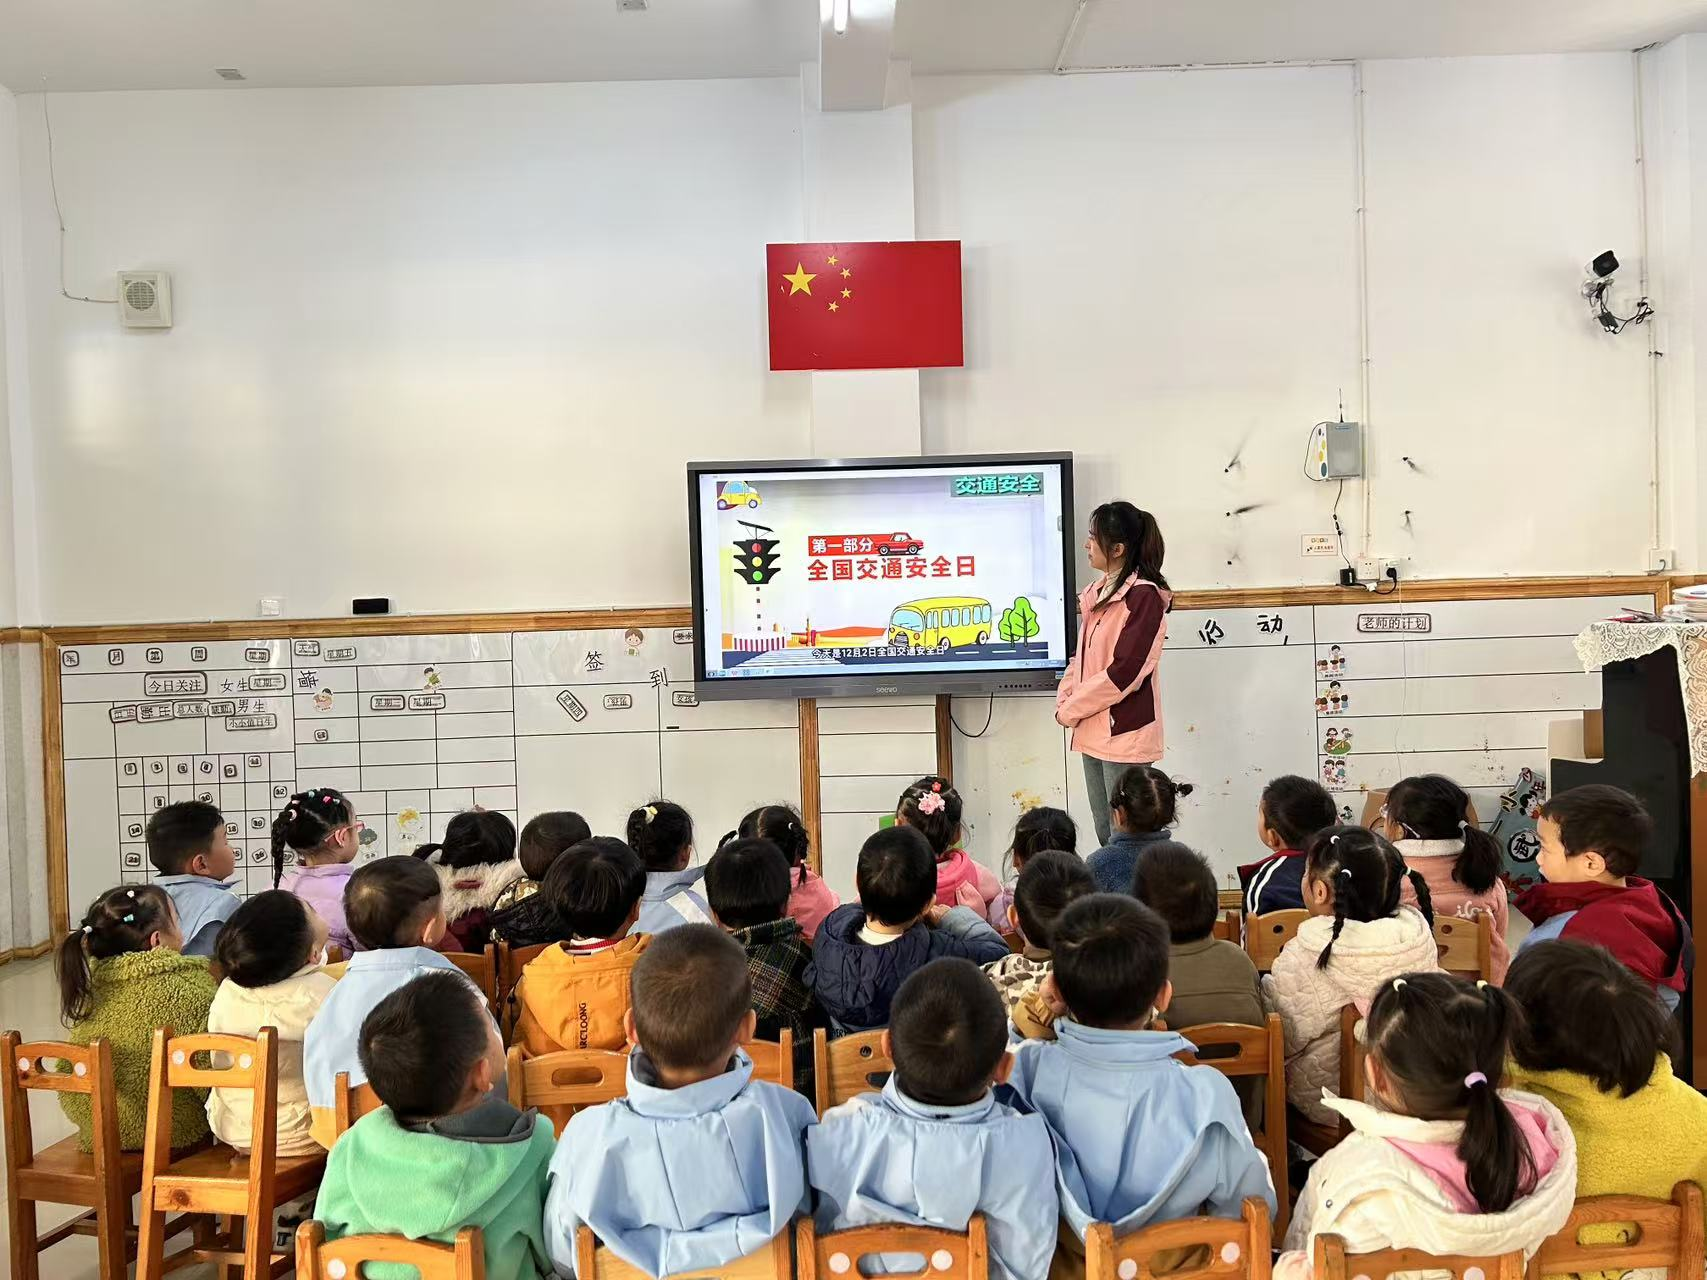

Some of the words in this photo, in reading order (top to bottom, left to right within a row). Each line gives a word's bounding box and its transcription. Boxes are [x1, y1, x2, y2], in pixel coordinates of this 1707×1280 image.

[955, 473, 1041, 495] 交通安全
[811, 537, 874, 554] 第一部分
[808, 556, 975, 581] 全国交通安全日
[1256, 614, 1283, 634] 动
[1361, 616, 1427, 630] 老师的计划
[111, 651, 121, 663] 月
[811, 646, 945, 659] 今天是12月2日全国交通安全日
[584, 650, 605, 672] 签
[220, 677, 249, 693] 女生
[649, 667, 669, 688] 到
[149, 679, 202, 693] 今日关注
[236, 699, 266, 713] 男生
[228, 716, 274, 729] 小小值日生
[227, 824, 237, 833] 18
